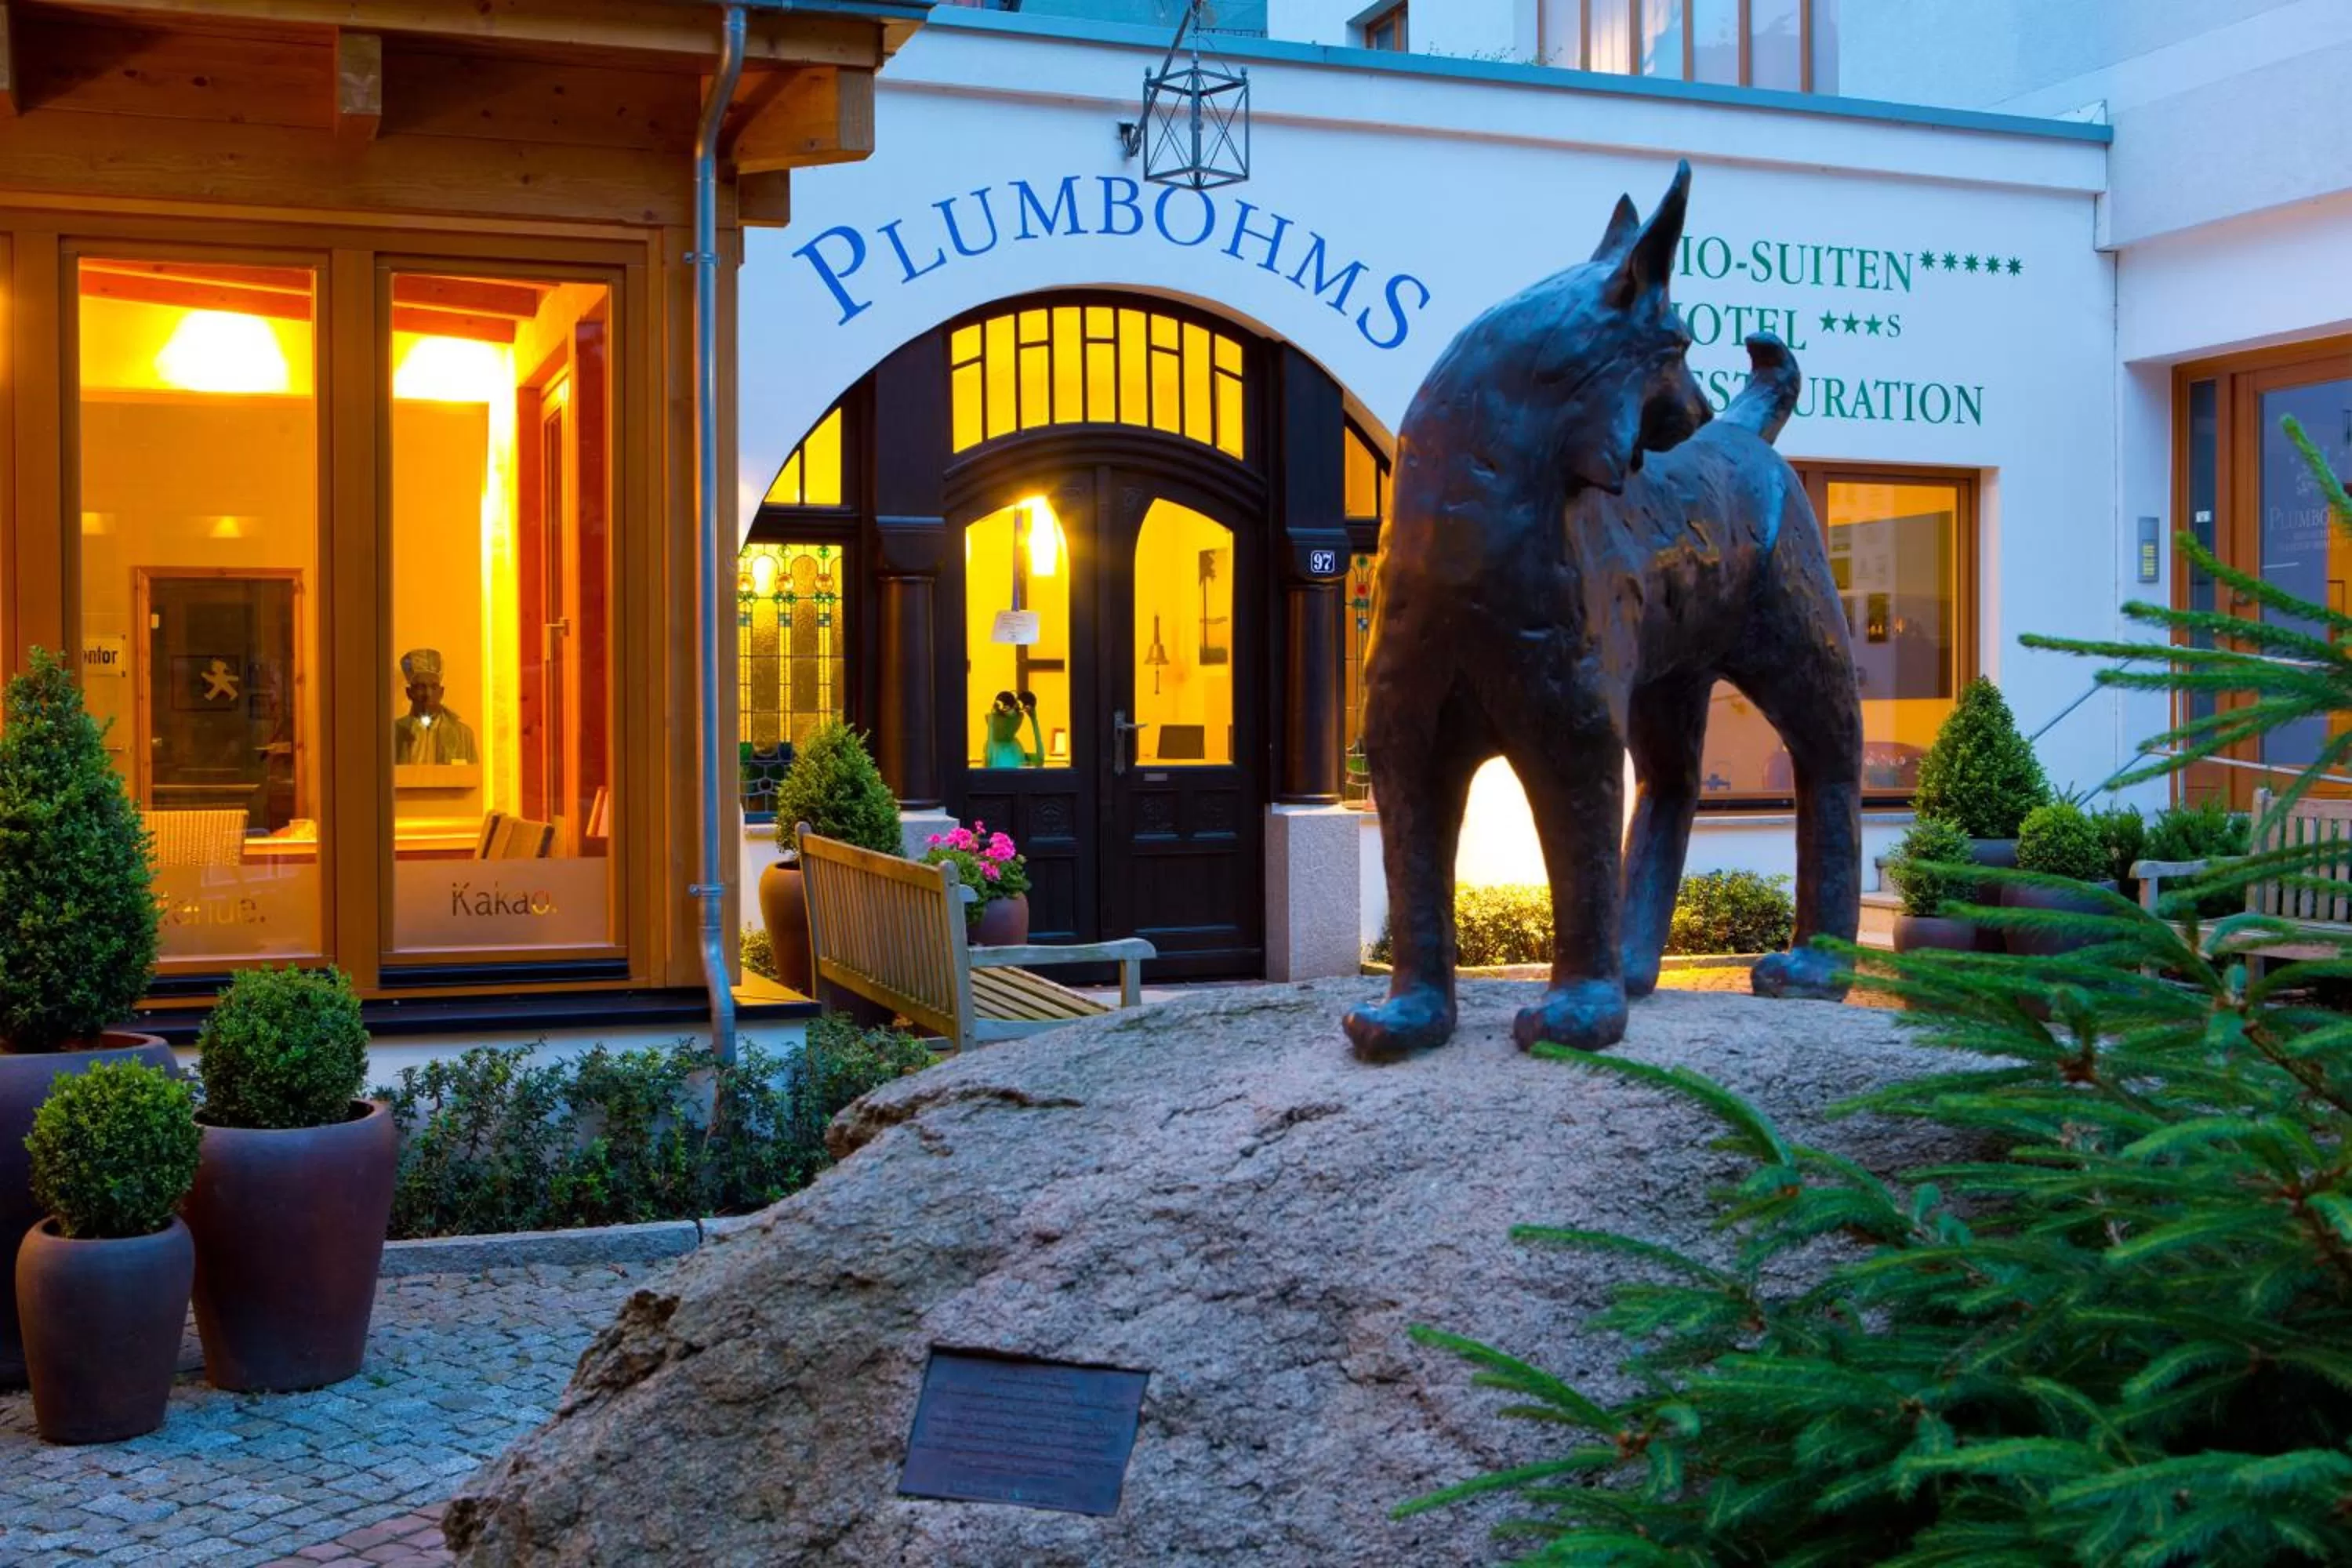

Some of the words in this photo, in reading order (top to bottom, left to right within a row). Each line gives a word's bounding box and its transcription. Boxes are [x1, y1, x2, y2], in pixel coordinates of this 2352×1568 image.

[792, 175, 1430, 350] PLUMBOHMS
[1671, 236, 1914, 292] IO-SUITEN
[1671, 302, 1806, 350] OTEL
[1313, 553, 1332, 570] 97
